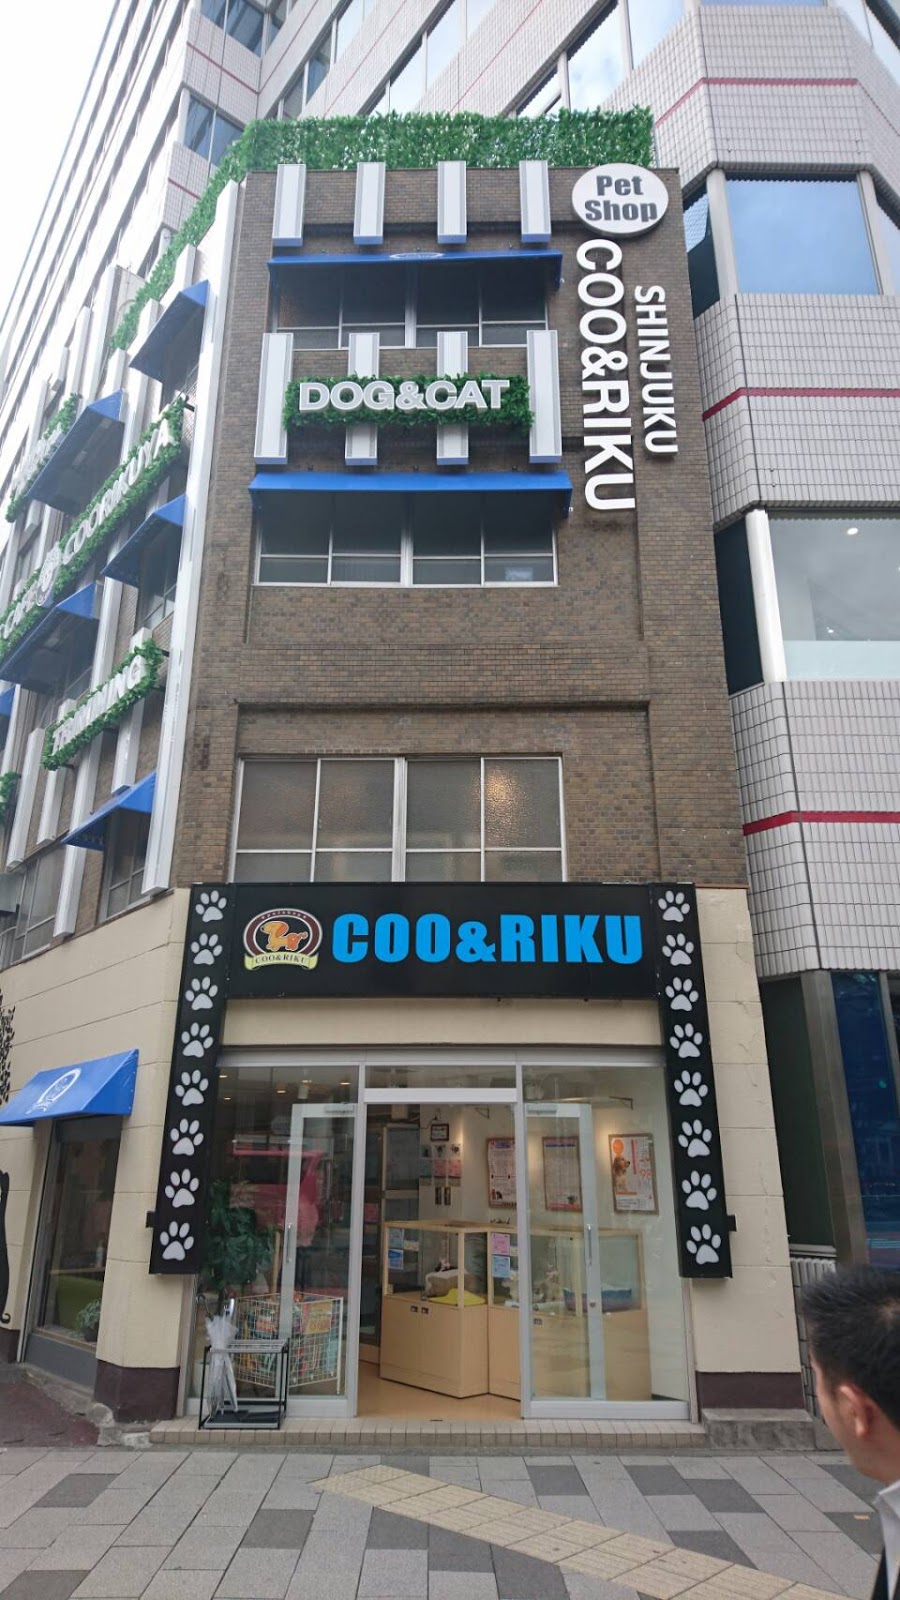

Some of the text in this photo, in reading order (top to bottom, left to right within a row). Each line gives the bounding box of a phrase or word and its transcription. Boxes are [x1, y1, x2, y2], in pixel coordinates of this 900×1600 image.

[596, 175, 644, 196] Pet
[584, 200, 658, 222] Shop
[576, 238, 636, 510] COO&RIKU
[634, 285, 679, 454] SHINJUKU
[299, 380, 510, 412] DOG&CAT
[332, 913, 643, 964] COO&RIKU
